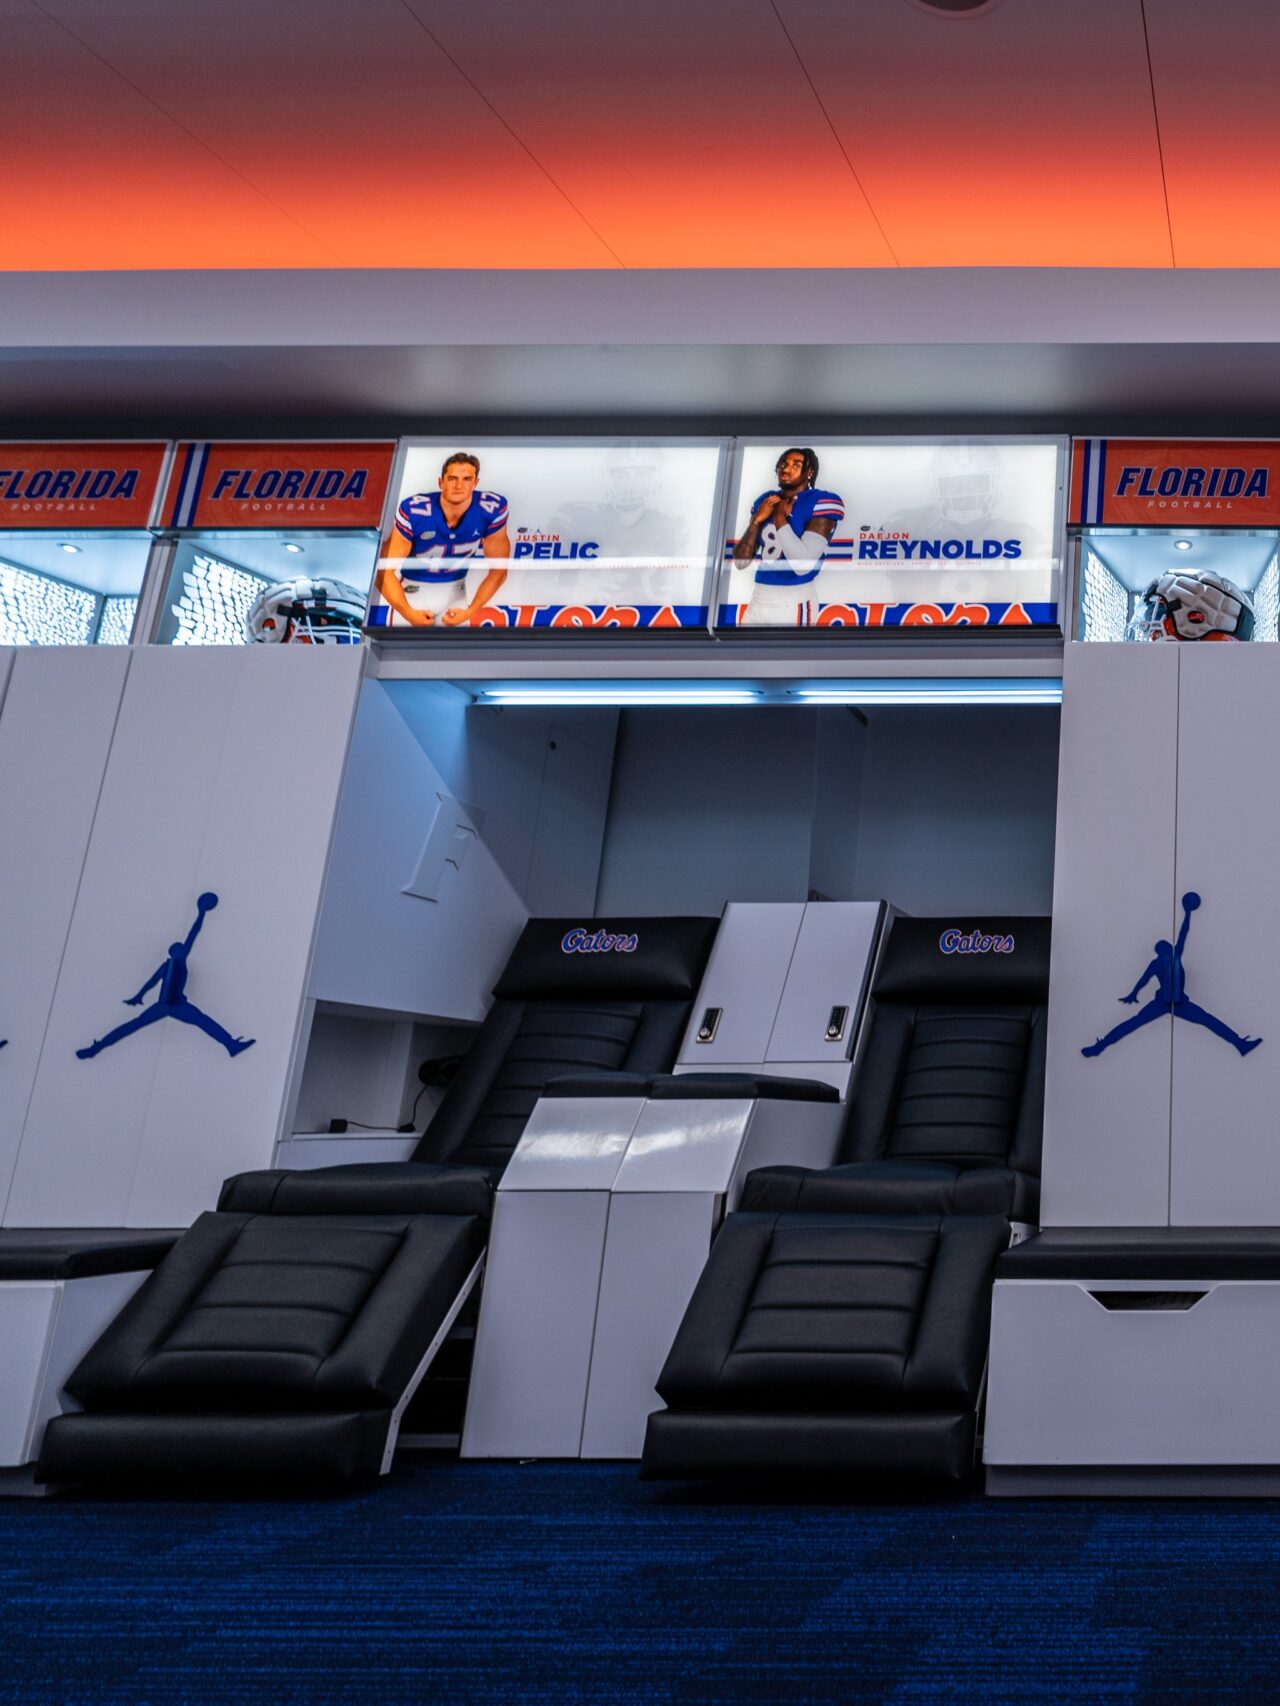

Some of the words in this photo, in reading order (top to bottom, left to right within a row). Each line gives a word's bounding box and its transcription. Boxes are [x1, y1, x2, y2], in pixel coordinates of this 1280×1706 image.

[209, 468, 369, 500] FLORIDA
[1113, 466, 1269, 498] FLORIDA
[10, 503, 96, 511] FOOTBALL
[240, 503, 326, 511] FOOTBALL
[1147, 500, 1233, 509] FOOTBALL
[859, 532, 910, 540] DAEJON
[513, 542, 600, 560] PELIC
[858, 540, 1023, 560] REYNOLDS
[561, 928, 639, 954] Gators
[939, 928, 1015, 954] Gators
